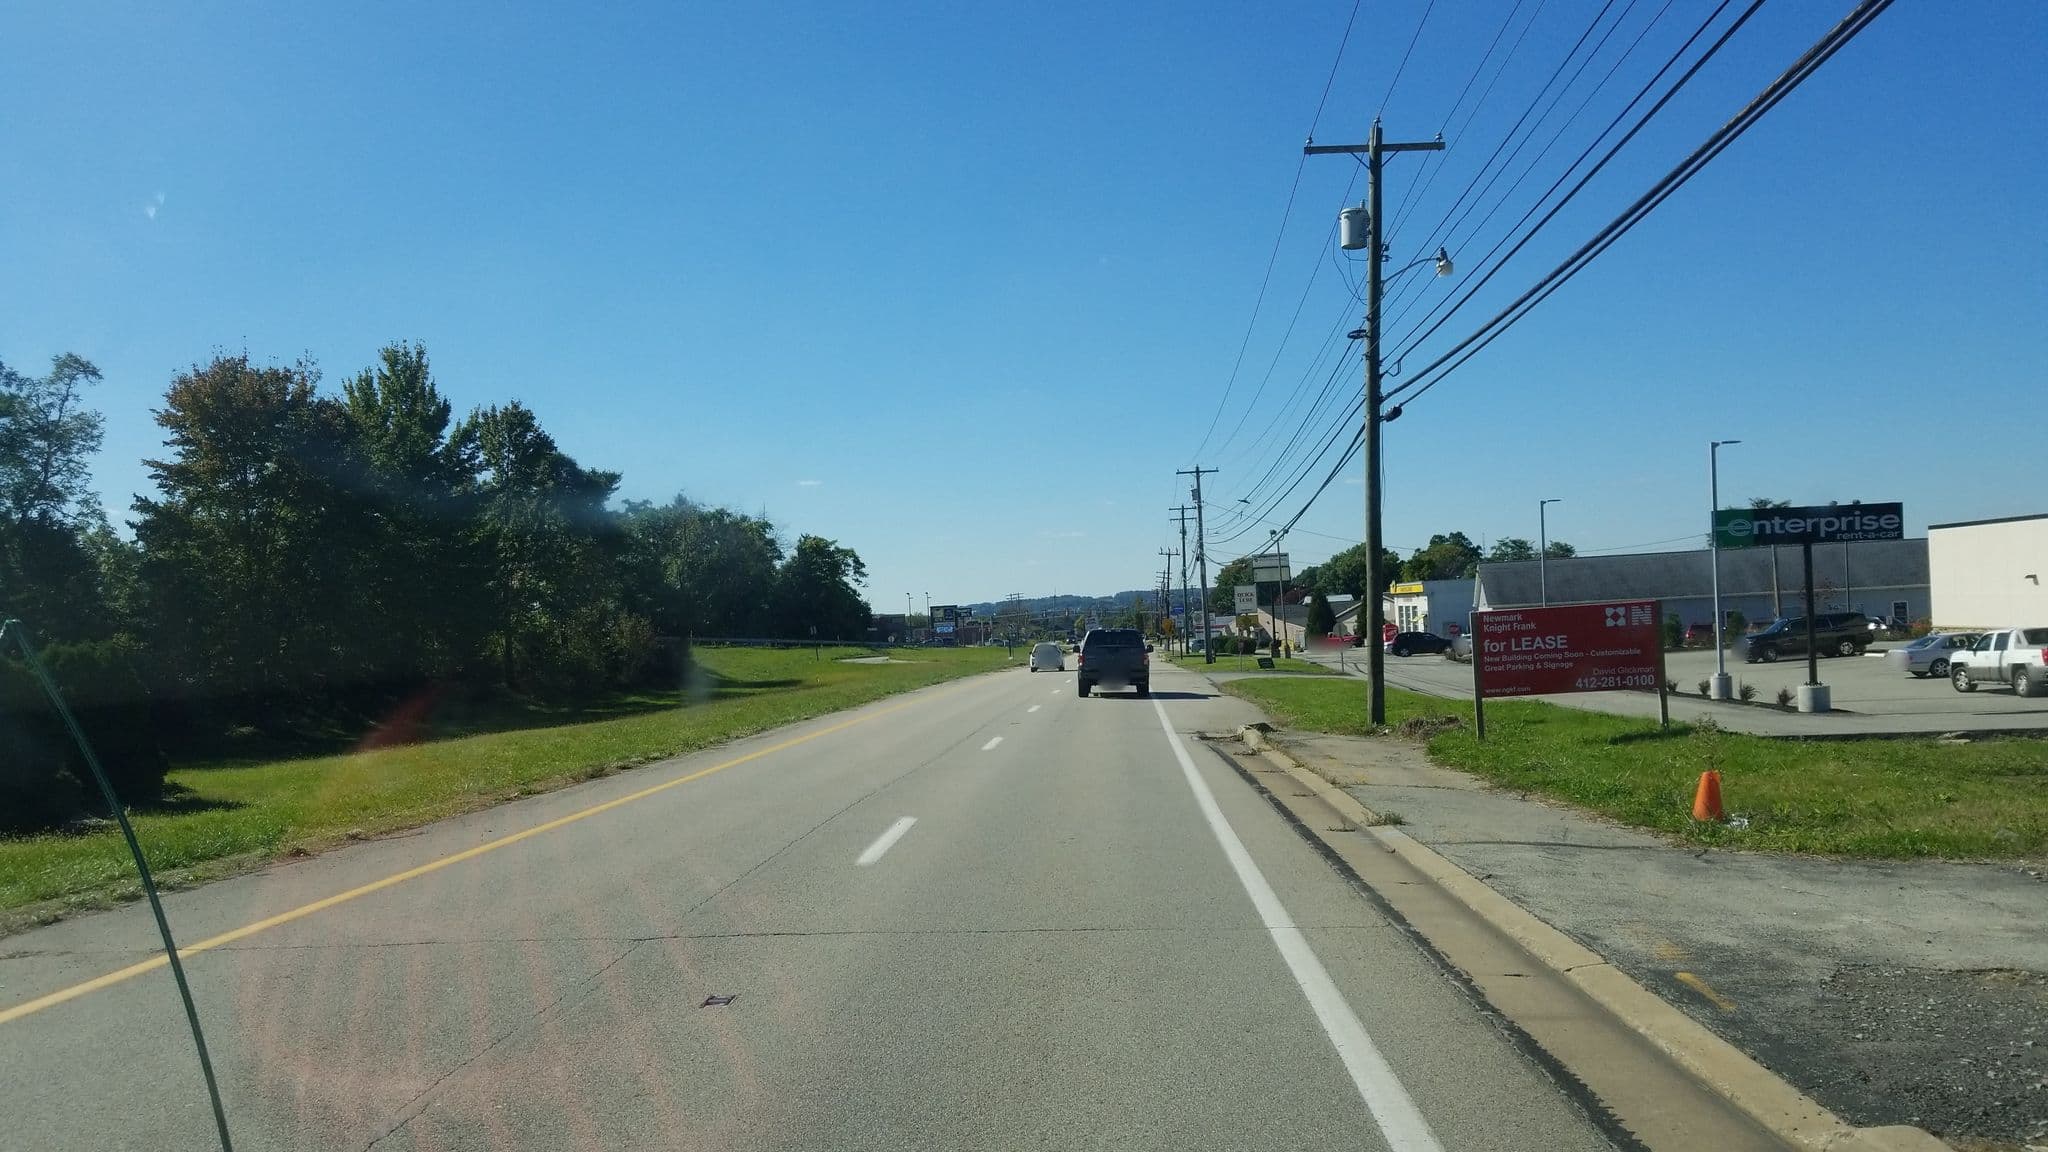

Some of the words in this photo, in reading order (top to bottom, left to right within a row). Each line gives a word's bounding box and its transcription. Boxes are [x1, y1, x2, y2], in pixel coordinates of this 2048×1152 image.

[1727, 511, 1900, 537] enterprise
[1836, 529, 1900, 541] rent-a-car
[1483, 613, 1522, 622] Newmark
[1483, 623, 1511, 633] Knight
[1513, 622, 1536, 631] Frank
[1483, 639, 1506, 653] for
[1511, 635, 1568, 651] LEASE
[1484, 655, 1500, 663] New
[1501, 653, 1532, 662] Building
[1533, 651, 1563, 661] Coming
[1590, 648, 1641, 657] Customizable
[1484, 663, 1505, 672] Great
[1506, 661, 1534, 670] Parking
[1543, 659, 1574, 669] Signage
[1592, 667, 1616, 676] David
[1575, 674, 1655, 688] 412-281-0100
